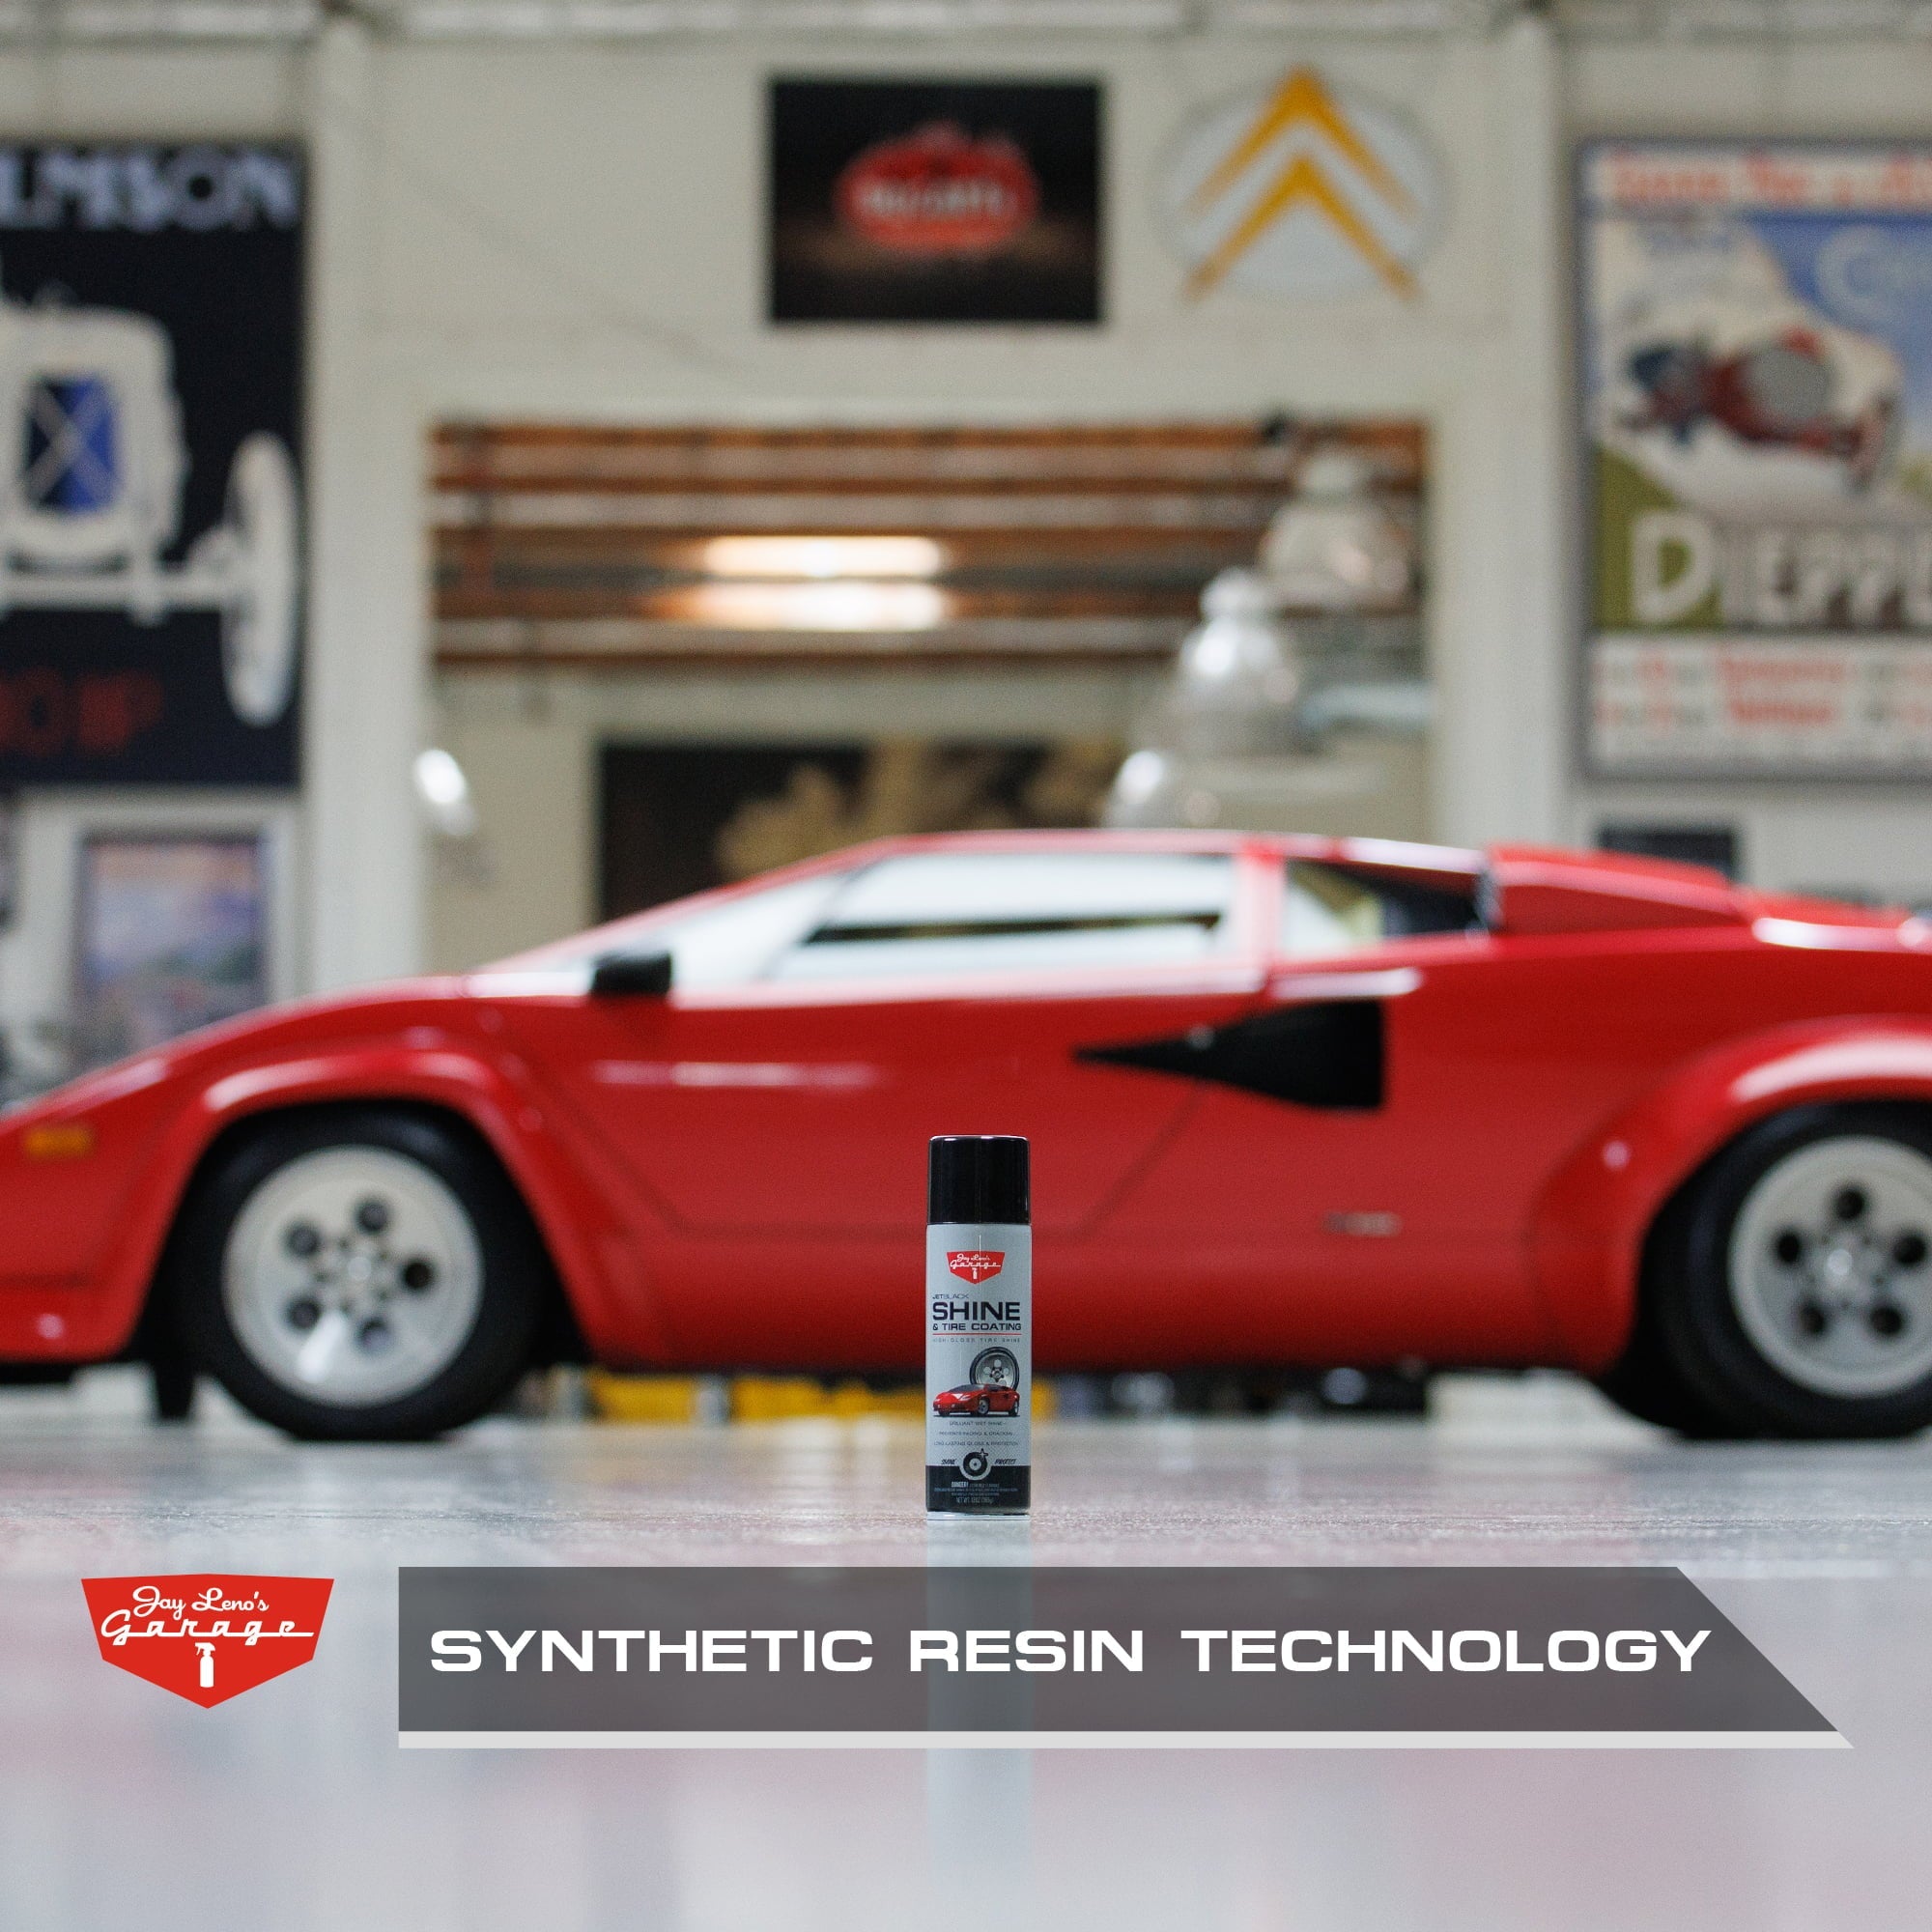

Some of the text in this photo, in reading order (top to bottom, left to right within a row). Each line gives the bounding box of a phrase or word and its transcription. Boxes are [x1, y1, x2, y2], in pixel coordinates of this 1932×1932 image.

[956, 1253, 970, 1263] Jay
[951, 1260, 1001, 1270] Garage
[932, 1301, 1021, 1321] SHINE
[932, 1322, 1022, 1331] & TIRE COATING
